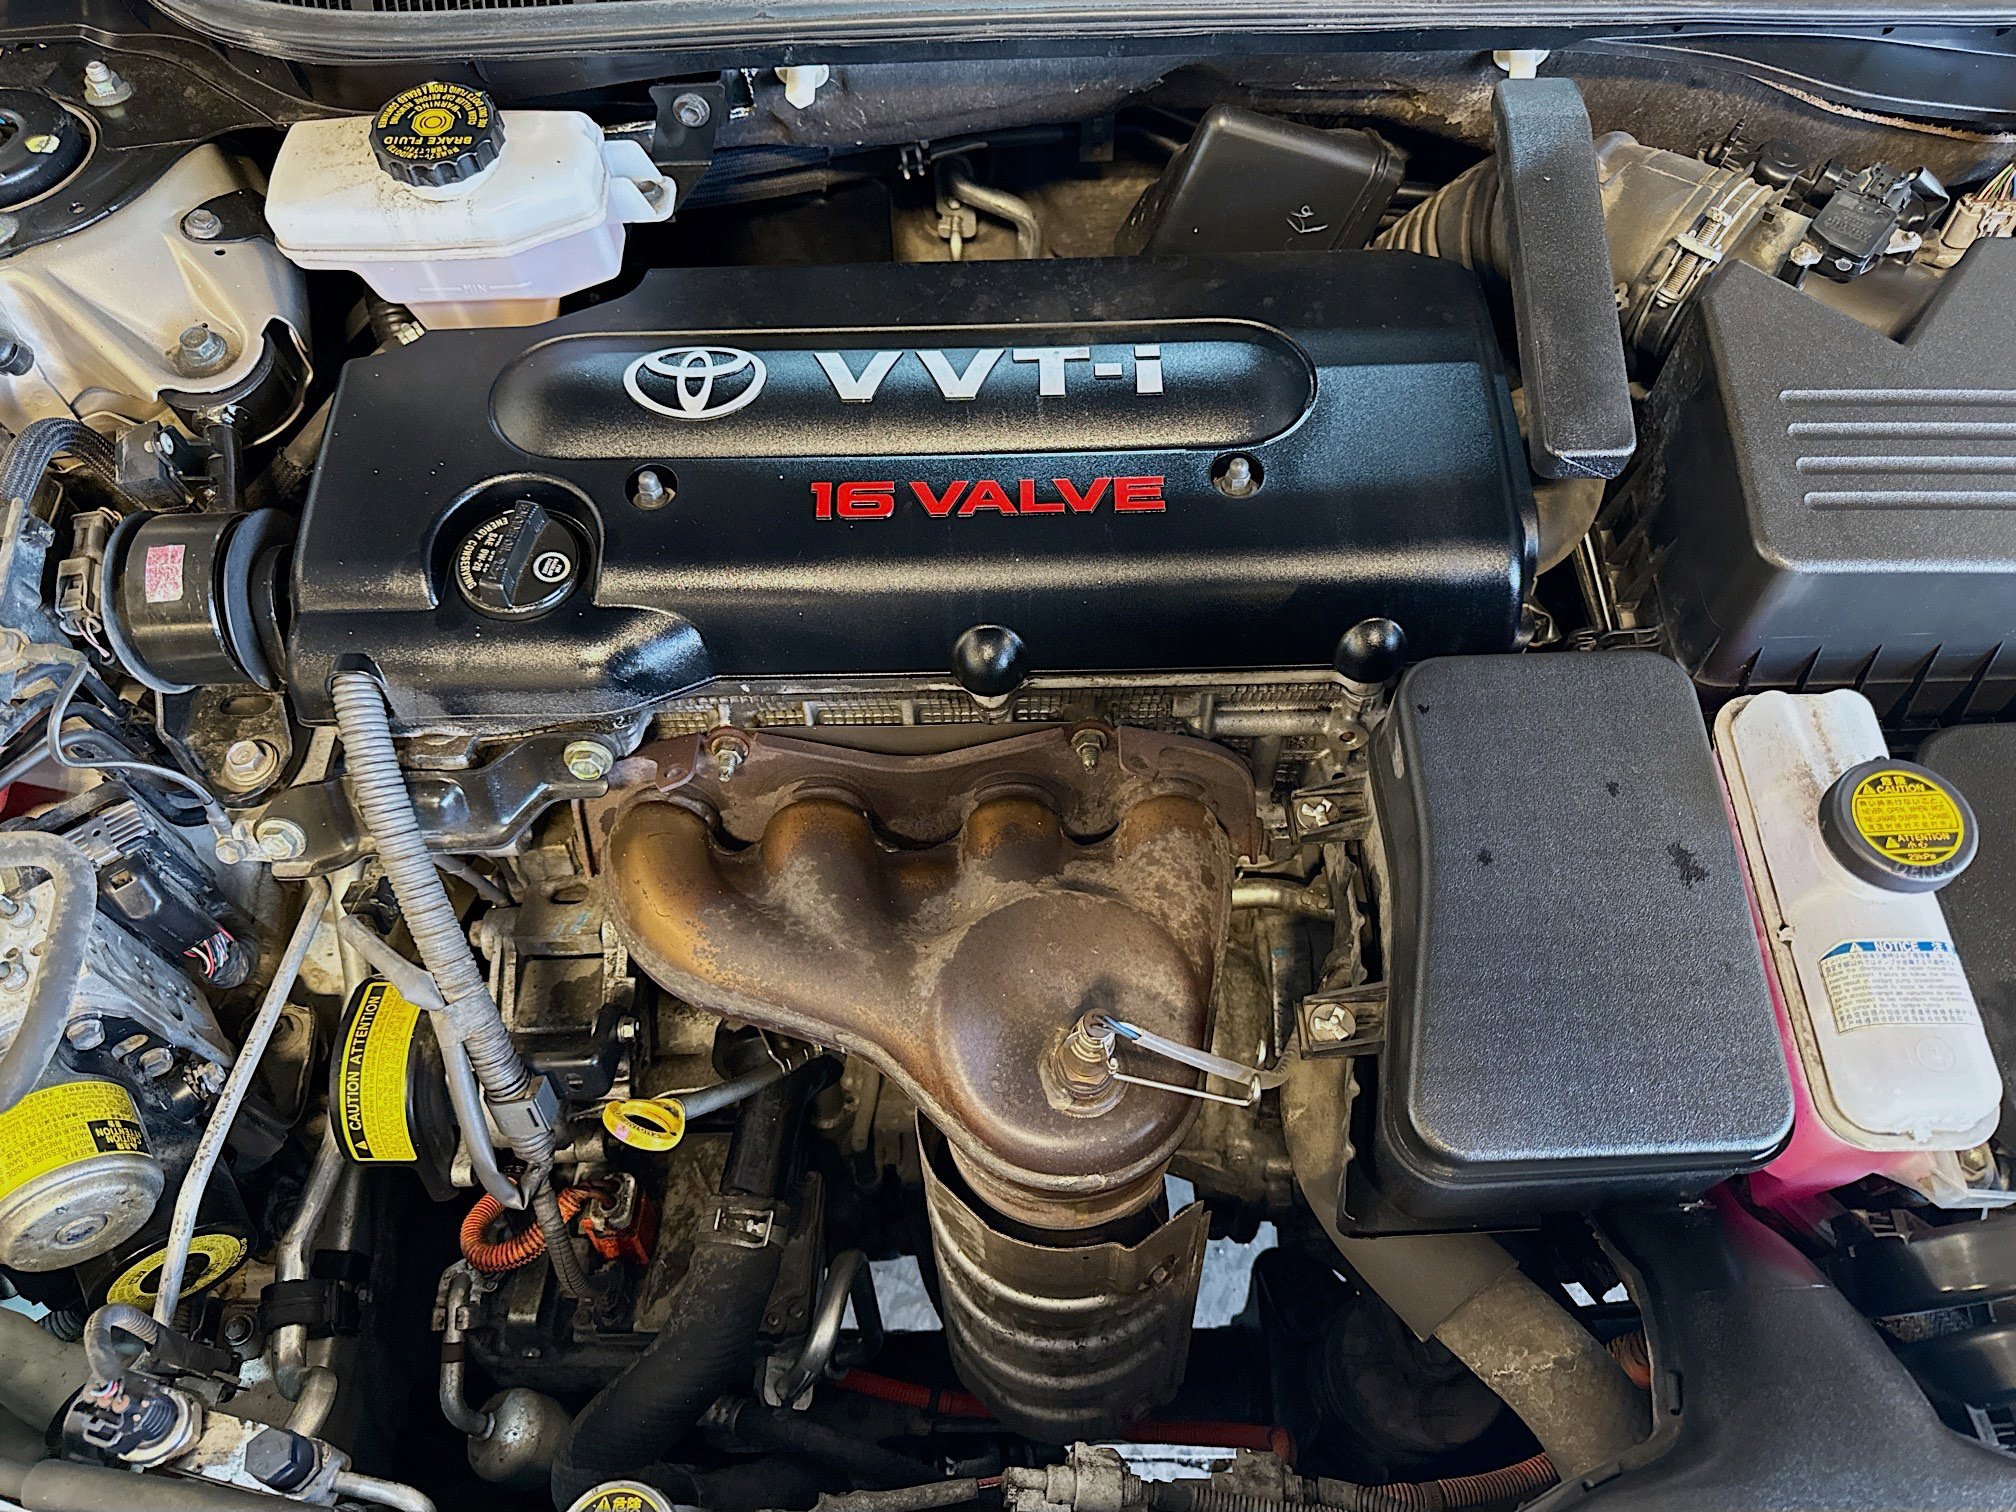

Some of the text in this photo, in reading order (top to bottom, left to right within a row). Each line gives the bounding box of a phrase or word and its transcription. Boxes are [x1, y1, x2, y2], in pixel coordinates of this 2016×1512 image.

[421, 86, 428, 94] A
[428, 84, 448, 93] FROM
[449, 85, 469, 97] FLUID
[397, 88, 423, 103] SEALED
[414, 93, 441, 104] BEFORE
[466, 93, 484, 107] DOT3
[414, 101, 460, 112] WARNING
[455, 97, 475, 111] FILLER
[383, 136, 473, 145] BRAKE FLUID
[462, 284, 489, 295] MIN
[814, 344, 1164, 402] VVT-i
[811, 475, 1166, 520] 16 VALVE
[474, 517, 508, 540] ENERGY
[484, 533, 498, 547] SAE
[460, 540, 478, 590] CONSERVING
[472, 549, 489, 571] 0W-20
[1876, 784, 1925, 794] CAUTION
[1897, 832, 1951, 842] ATTENTION
[1907, 841, 1928, 849] 小心
[1874, 941, 1920, 952] NOTICE
[346, 995, 382, 1131] CAUTION ATTENTION
[95, 1127, 141, 1138] ATTENTION
[105, 1134, 141, 1144] CAUTION
[5, 1132, 89, 1169] HAUTE PRESSION DANS
[6, 1140, 91, 1179] HIGH PRESSURE INSIDE
